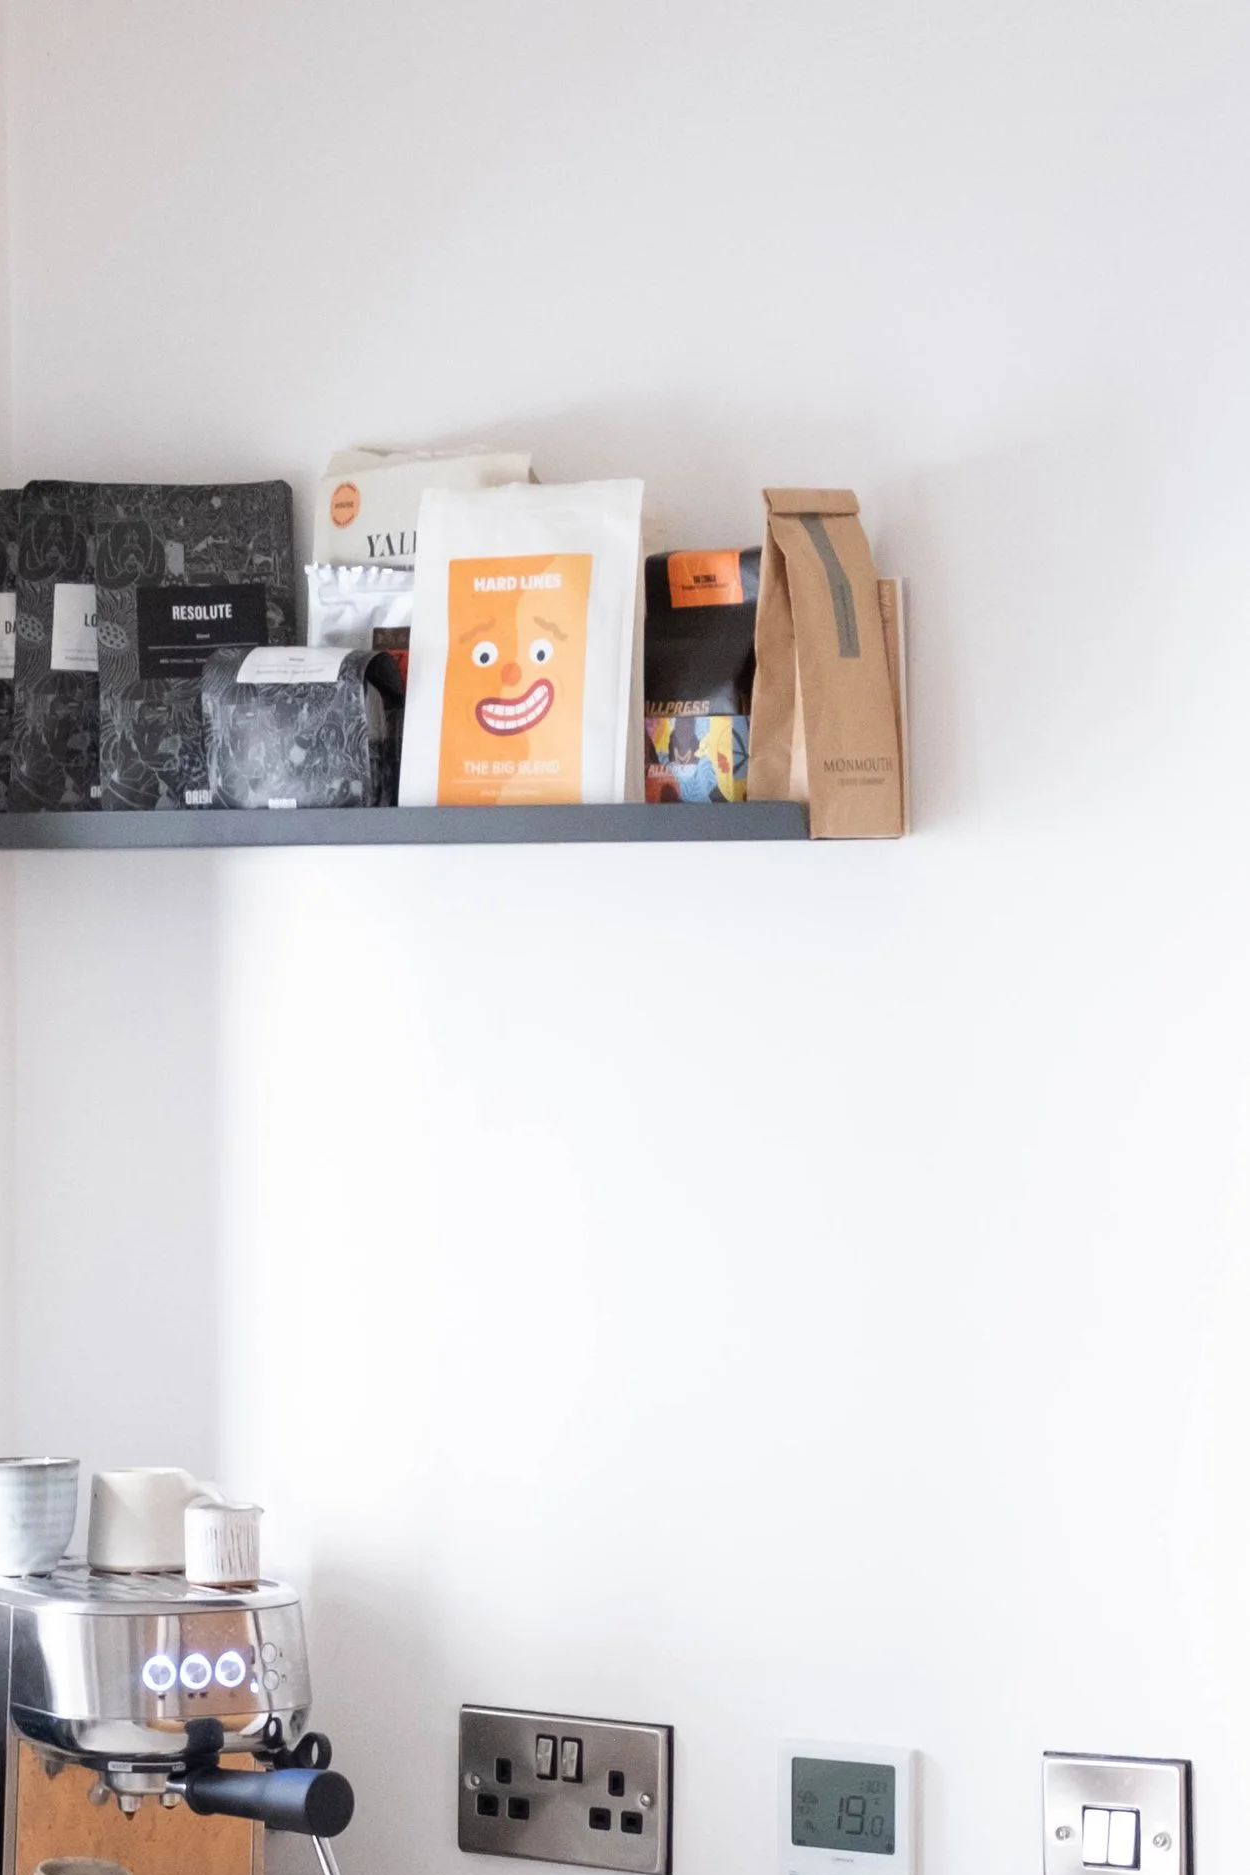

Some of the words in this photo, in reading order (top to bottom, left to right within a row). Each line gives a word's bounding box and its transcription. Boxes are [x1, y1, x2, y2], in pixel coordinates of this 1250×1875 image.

[473, 576, 517, 592] HARD
[520, 573, 563, 590] LINES
[172, 604, 232, 620] RESOLUTE
[463, 761, 490, 775] THE
[492, 761, 515, 774] BIG
[518, 760, 560, 774] BLEND
[823, 757, 893, 773] MONMOUTH
